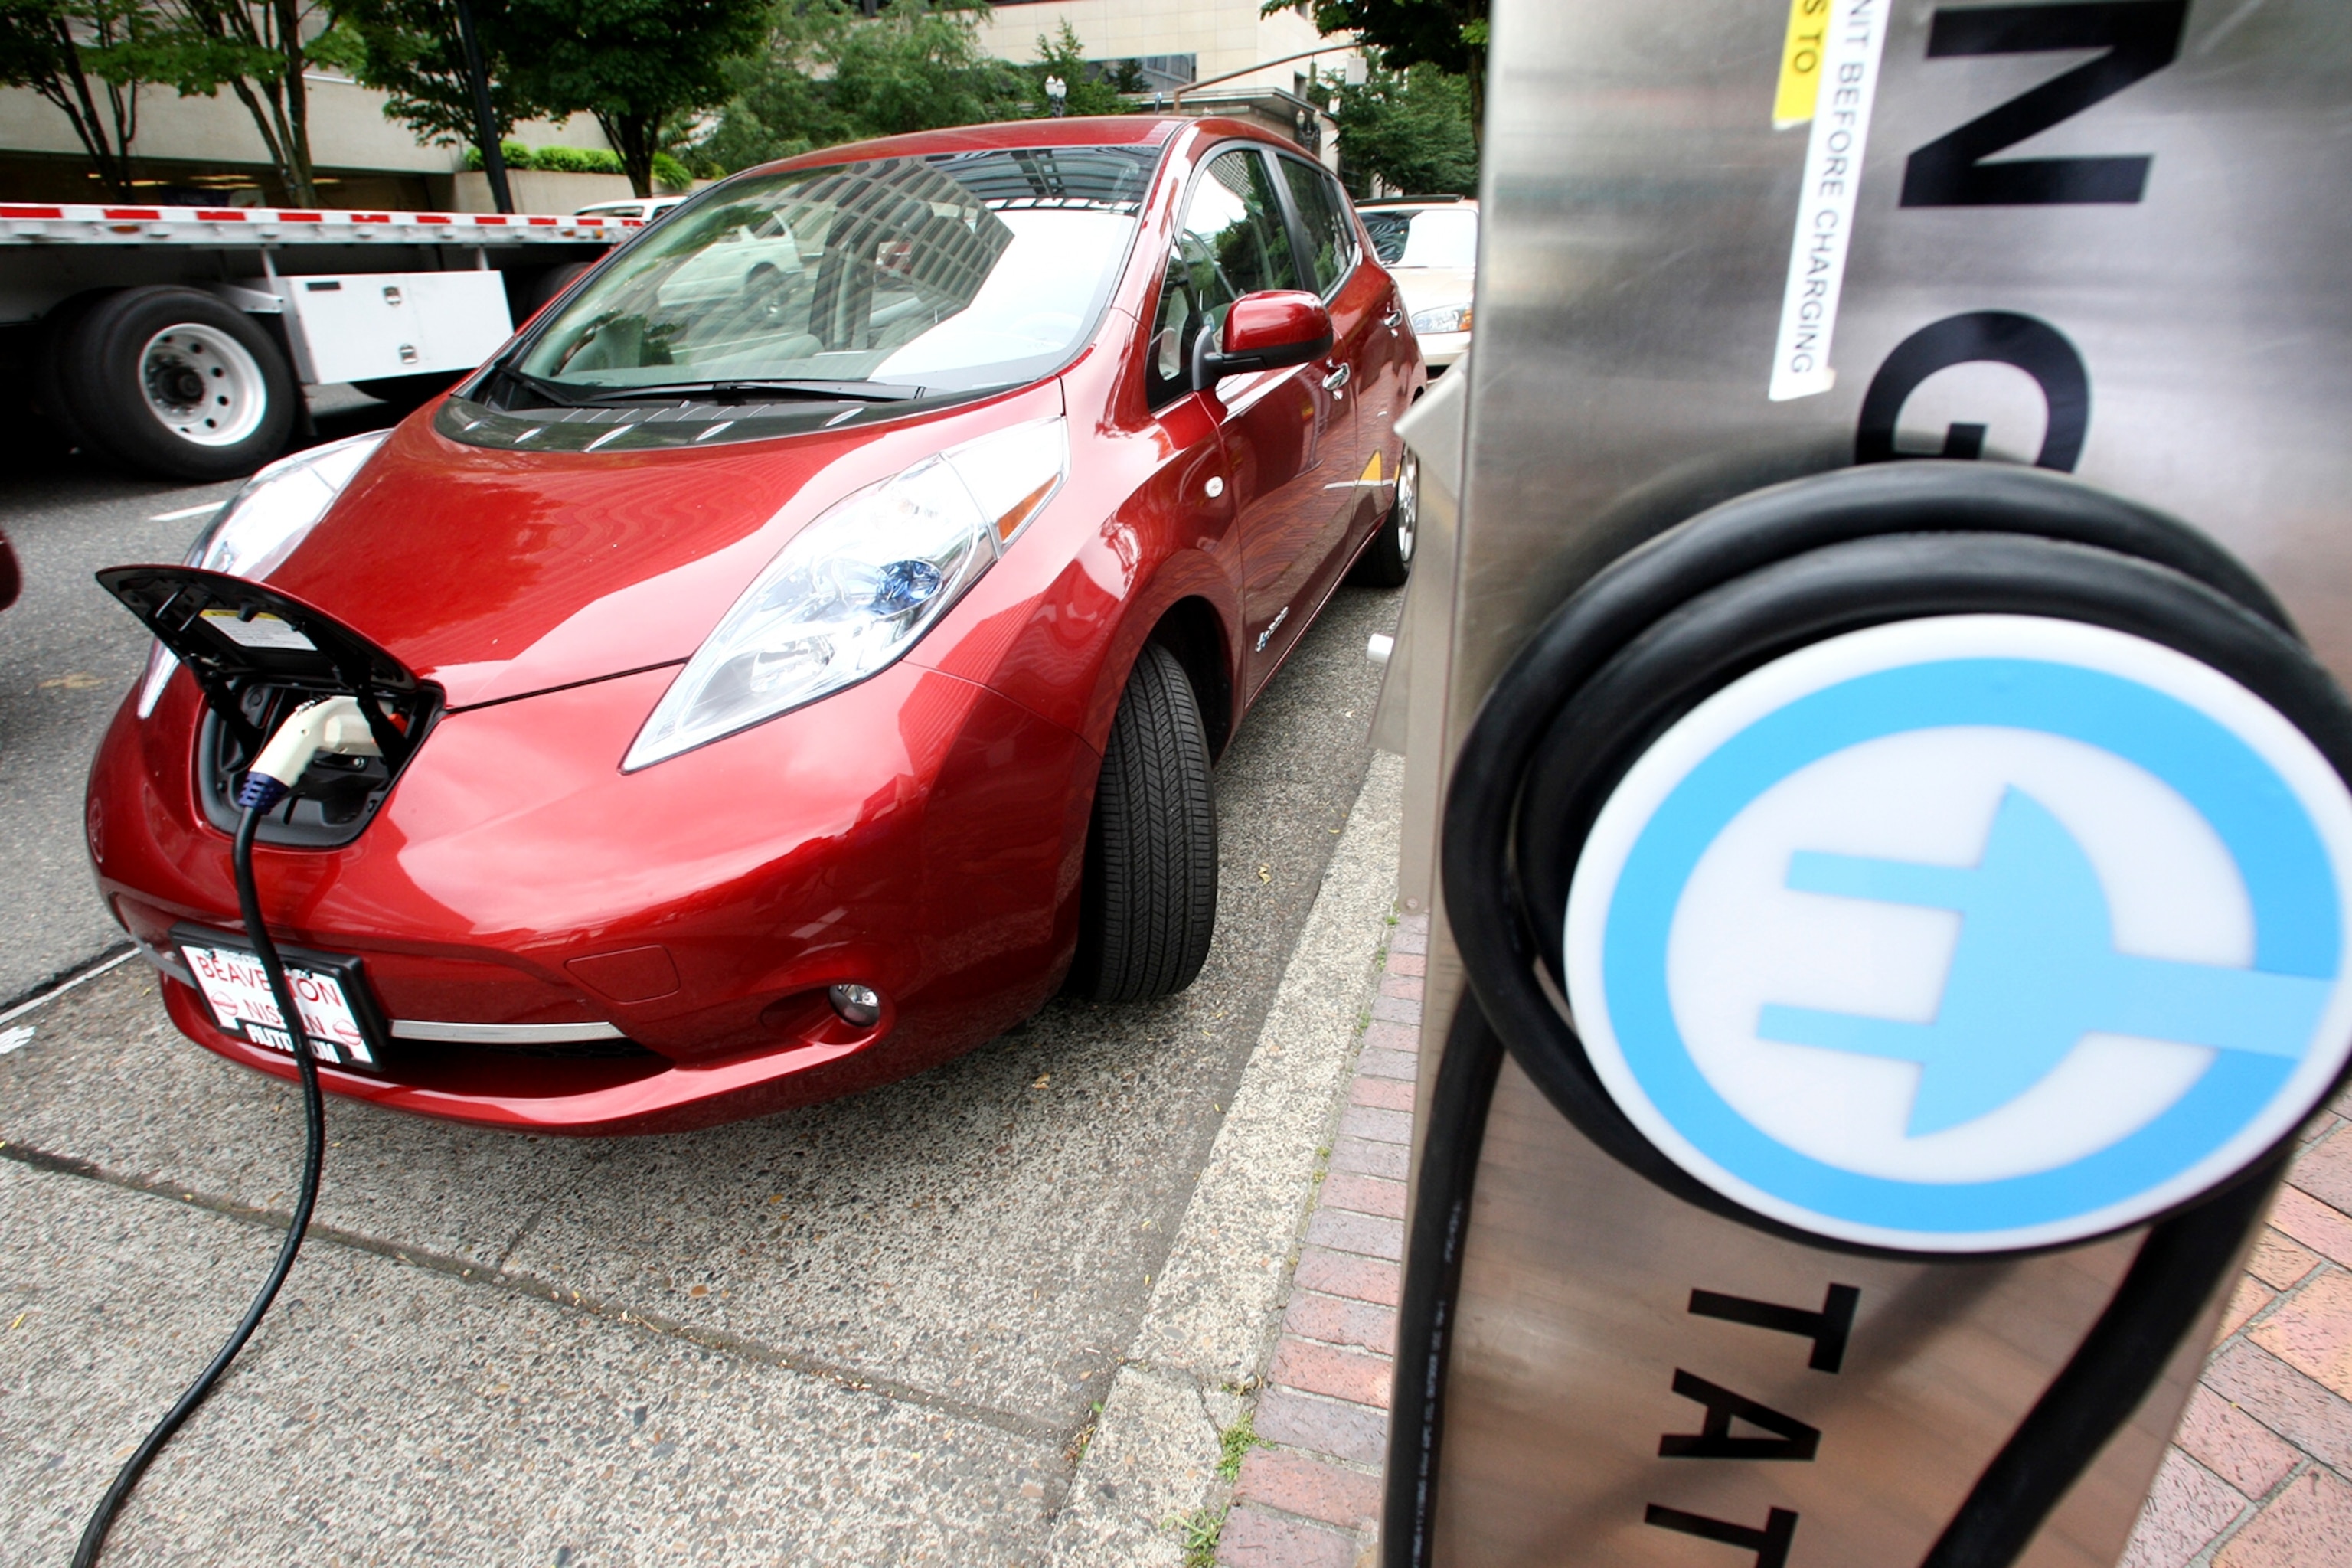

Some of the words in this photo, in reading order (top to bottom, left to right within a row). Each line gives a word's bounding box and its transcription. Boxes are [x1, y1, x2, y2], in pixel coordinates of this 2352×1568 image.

[1794, 28, 1824, 74] TO
[1818, 62, 1864, 198] BEFORE
[1789, 207, 1838, 374] CHARGING
[196, 956, 342, 1008] BEAVETON
[243, 998, 327, 1036] NISN
